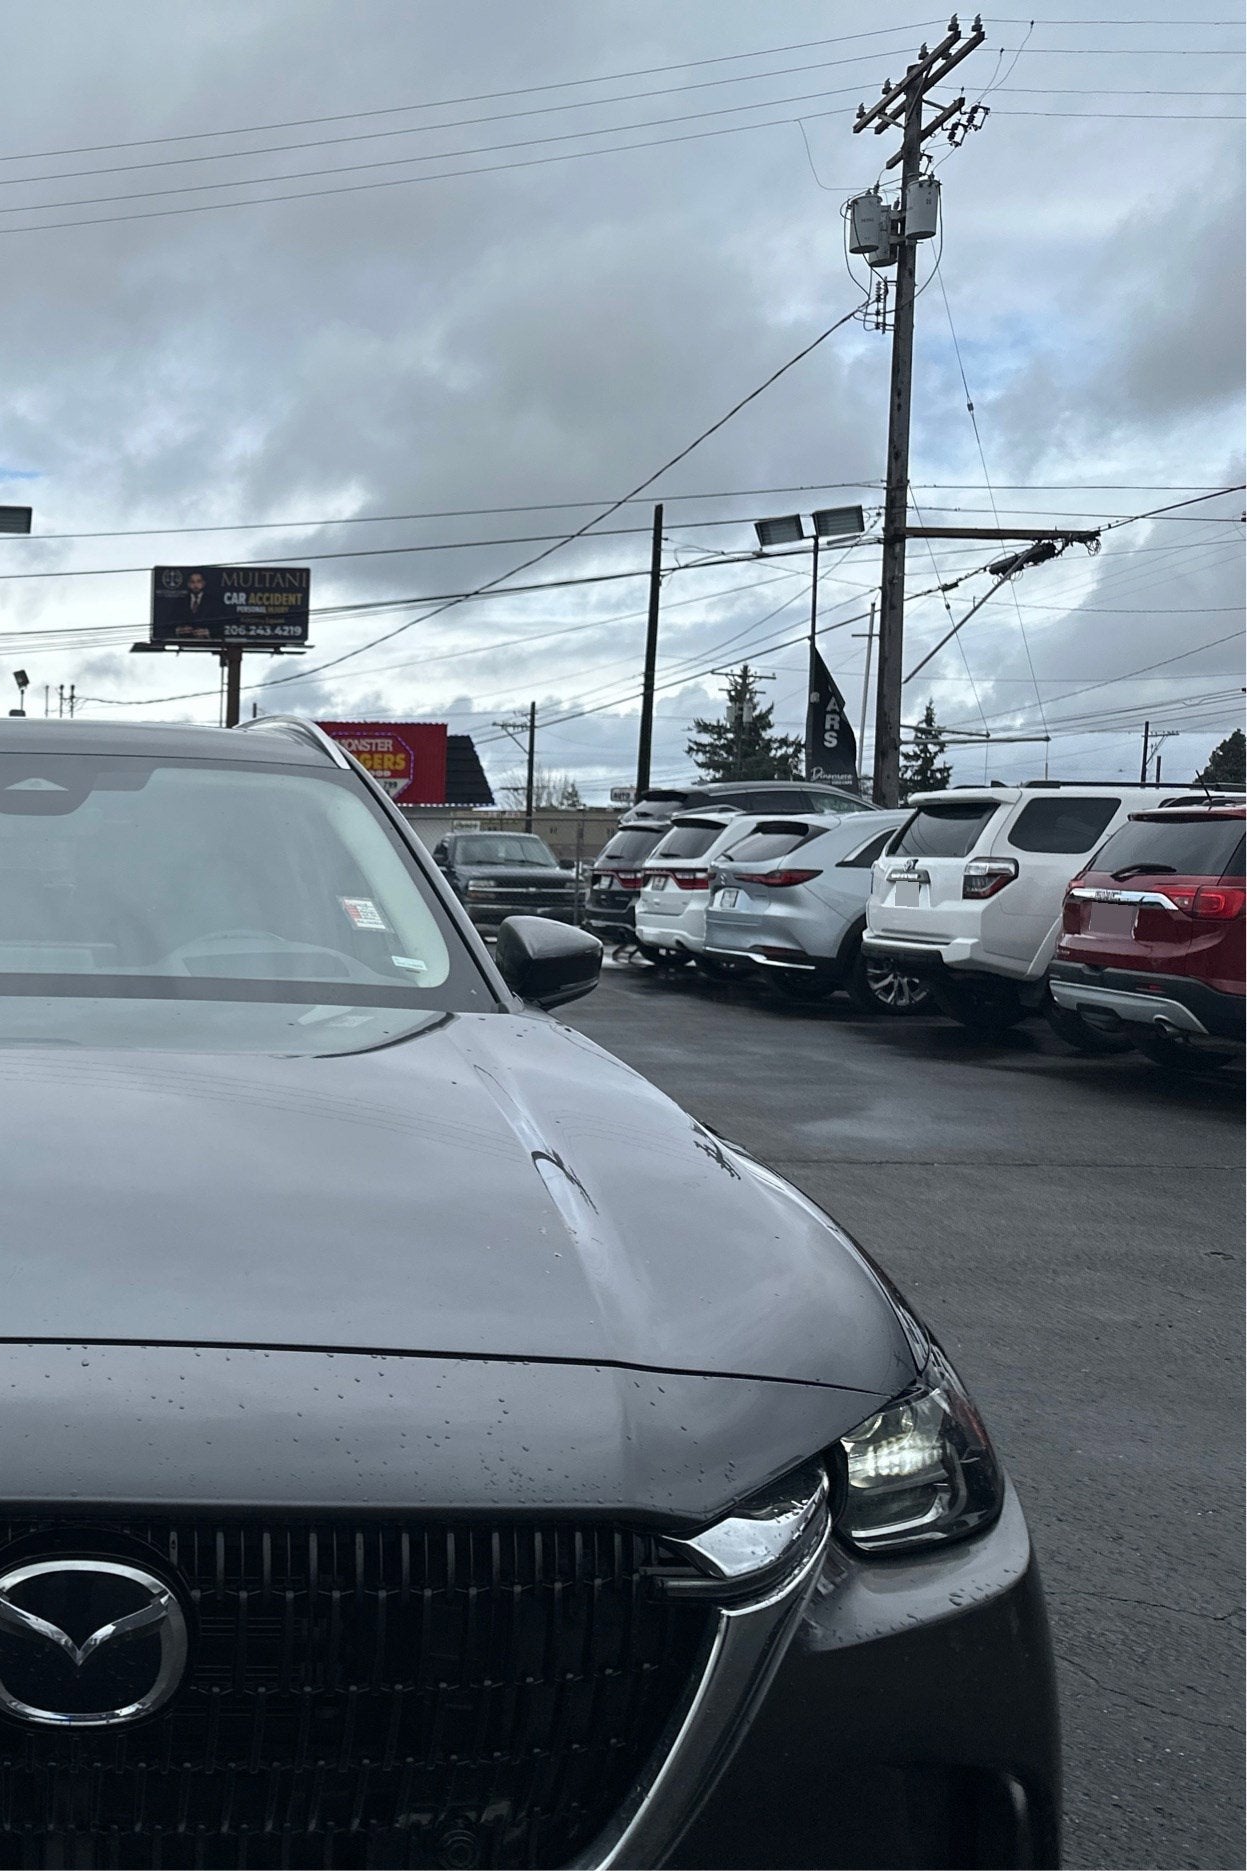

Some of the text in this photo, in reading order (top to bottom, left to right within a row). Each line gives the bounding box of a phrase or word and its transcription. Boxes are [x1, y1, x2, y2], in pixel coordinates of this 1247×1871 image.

[221, 571, 307, 588] MULTANI
[224, 592, 303, 606] CAR ACCIDENT
[236, 605, 266, 614] PERSONAL
[224, 625, 302, 636] 206.243.4219
